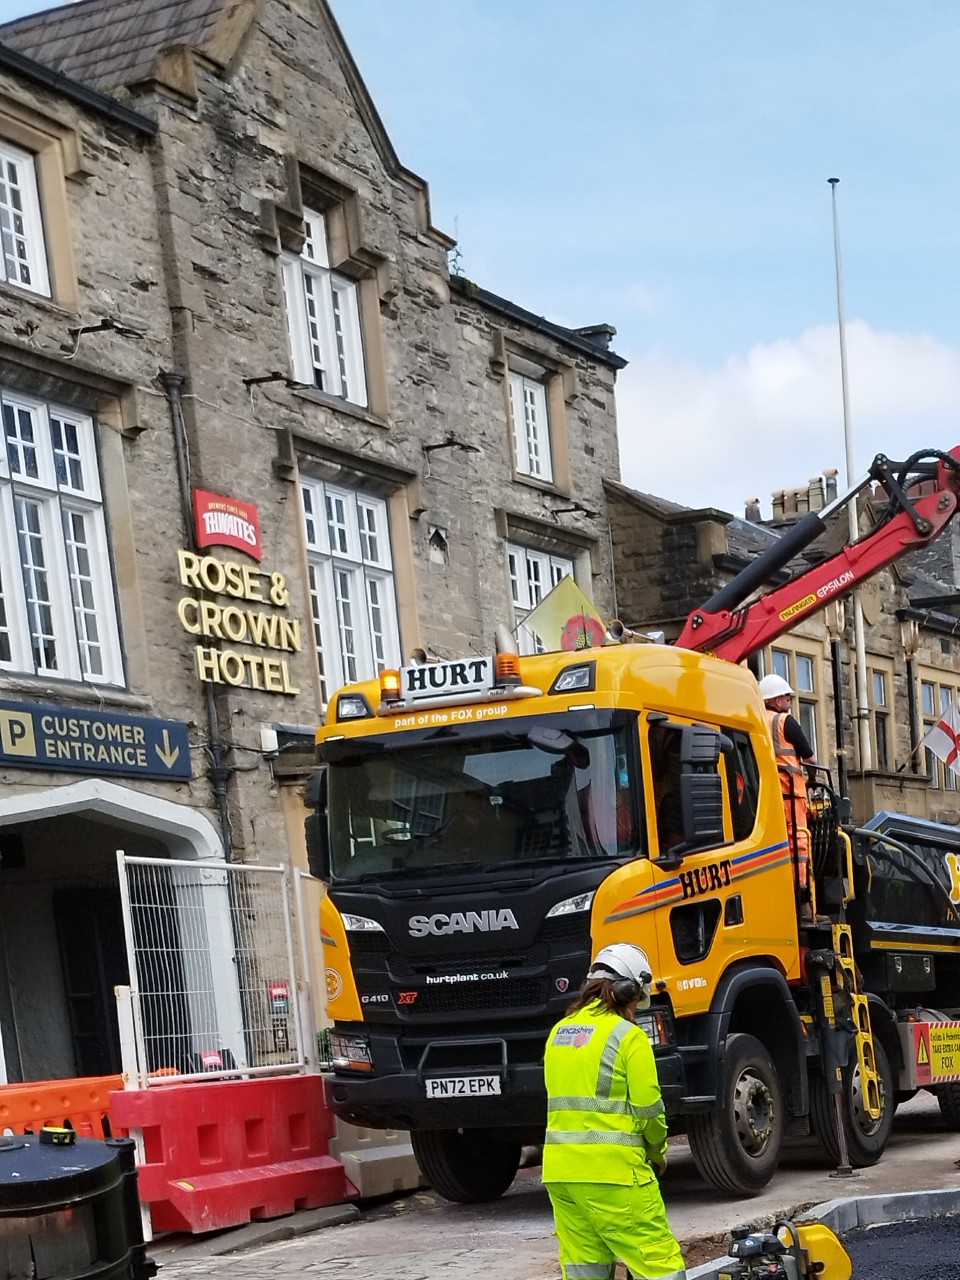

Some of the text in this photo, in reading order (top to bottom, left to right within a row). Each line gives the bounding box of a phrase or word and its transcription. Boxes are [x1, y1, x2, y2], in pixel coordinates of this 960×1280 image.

[202, 511, 257, 546] THWAITES
[178, 549, 291, 606] ROSE &
[816, 570, 855, 598] EPSILON
[177, 597, 301, 652] CROWN
[194, 645, 301, 695] HOTEL
[406, 660, 488, 692] HURT
[41, 715, 146, 746] CUSTOMER
[394, 704, 509, 728] part of the FOX group
[8, 718, 27, 747] P
[44, 739, 148, 768] ENTRANCE
[678, 858, 732, 900] HURT
[408, 908, 520, 938] SCANIA
[361, 994, 389, 1004] G410
[398, 992, 418, 1004] XT
[556, 1026, 593, 1035] Lancashire
[932, 1044, 942, 1054] TAKE
[942, 1043, 954, 1054] EXTRA
[941, 1056, 954, 1069] FOX
[430, 1077, 496, 1096] PN72 EPK
